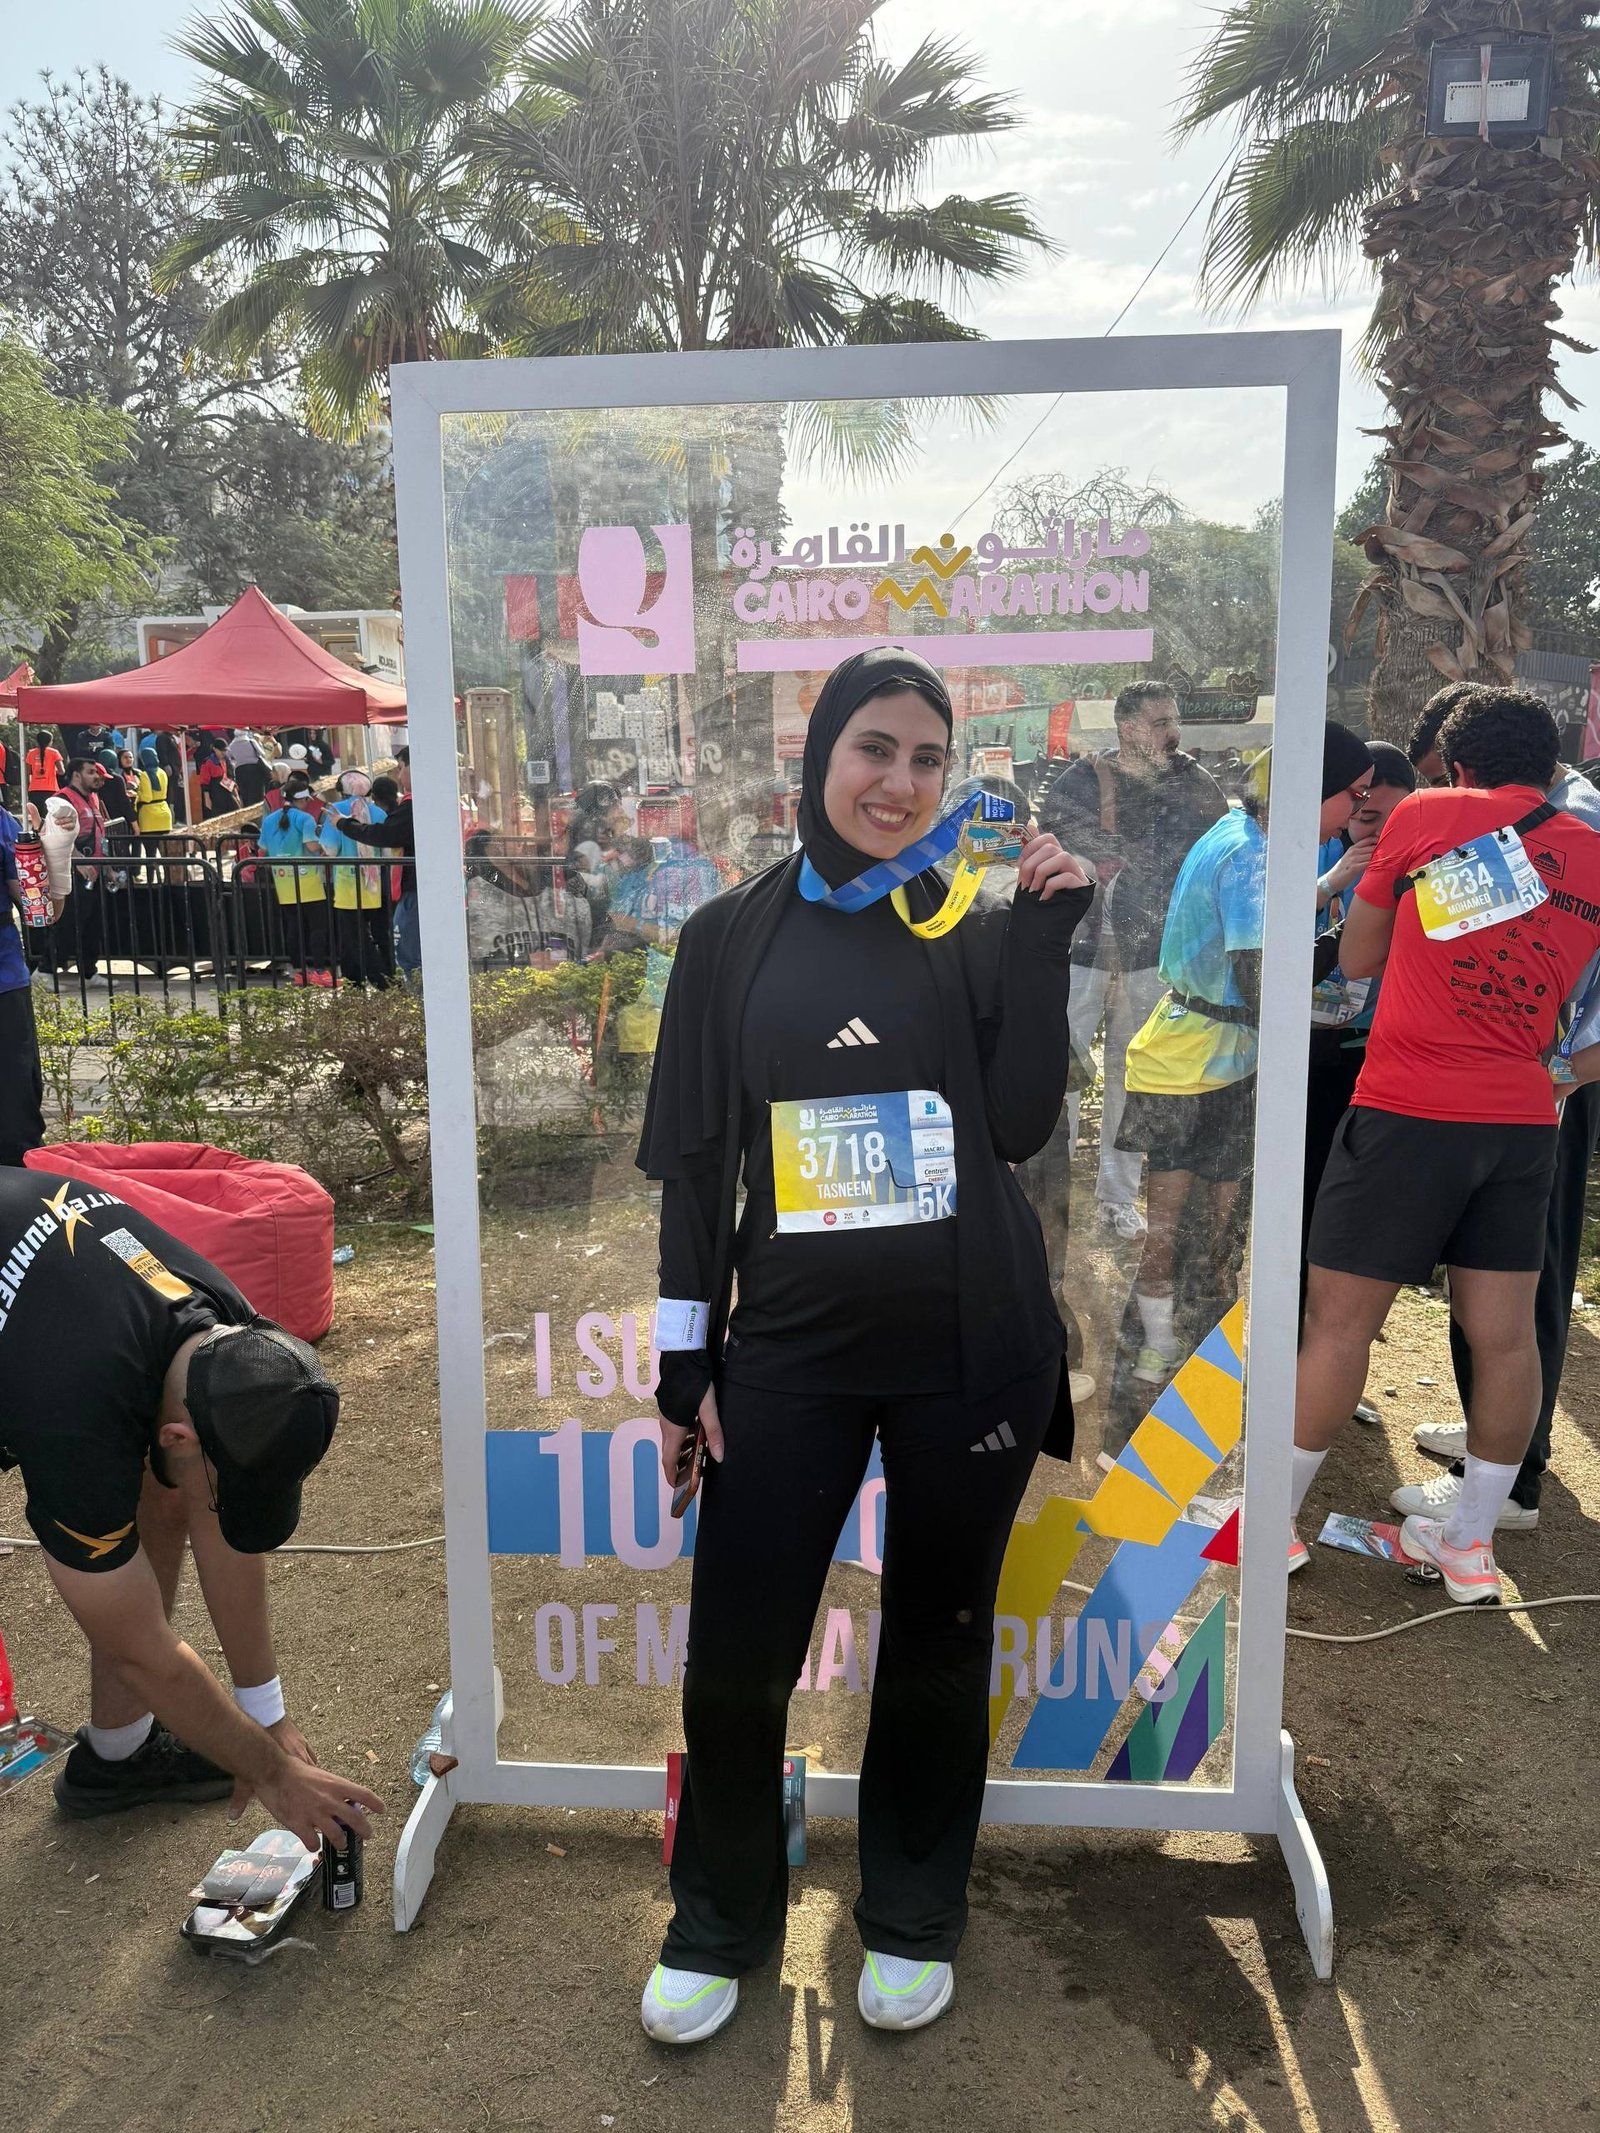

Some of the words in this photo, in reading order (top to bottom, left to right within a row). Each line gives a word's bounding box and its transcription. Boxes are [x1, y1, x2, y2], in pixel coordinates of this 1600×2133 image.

[731, 524, 905, 580] القاهرة
[733, 579, 870, 624] CAIRO
[1431, 862, 1494, 906] 3234
[1520, 879, 1548, 909] 5K
[1447, 893, 1491, 916] MOHAMED
[820, 1114, 839, 1122] CAIRO
[797, 1131, 887, 1180] 3718
[924, 1167, 949, 1176] Centrum
[816, 1180, 872, 1200] TASNEEM
[917, 1184, 952, 1220] 5K
[140, 1262, 167, 1282] RUN
[534, 1312, 552, 1398] I
[535, 1602, 618, 1686] OF
[990, 1615, 1178, 1703] RUNS
